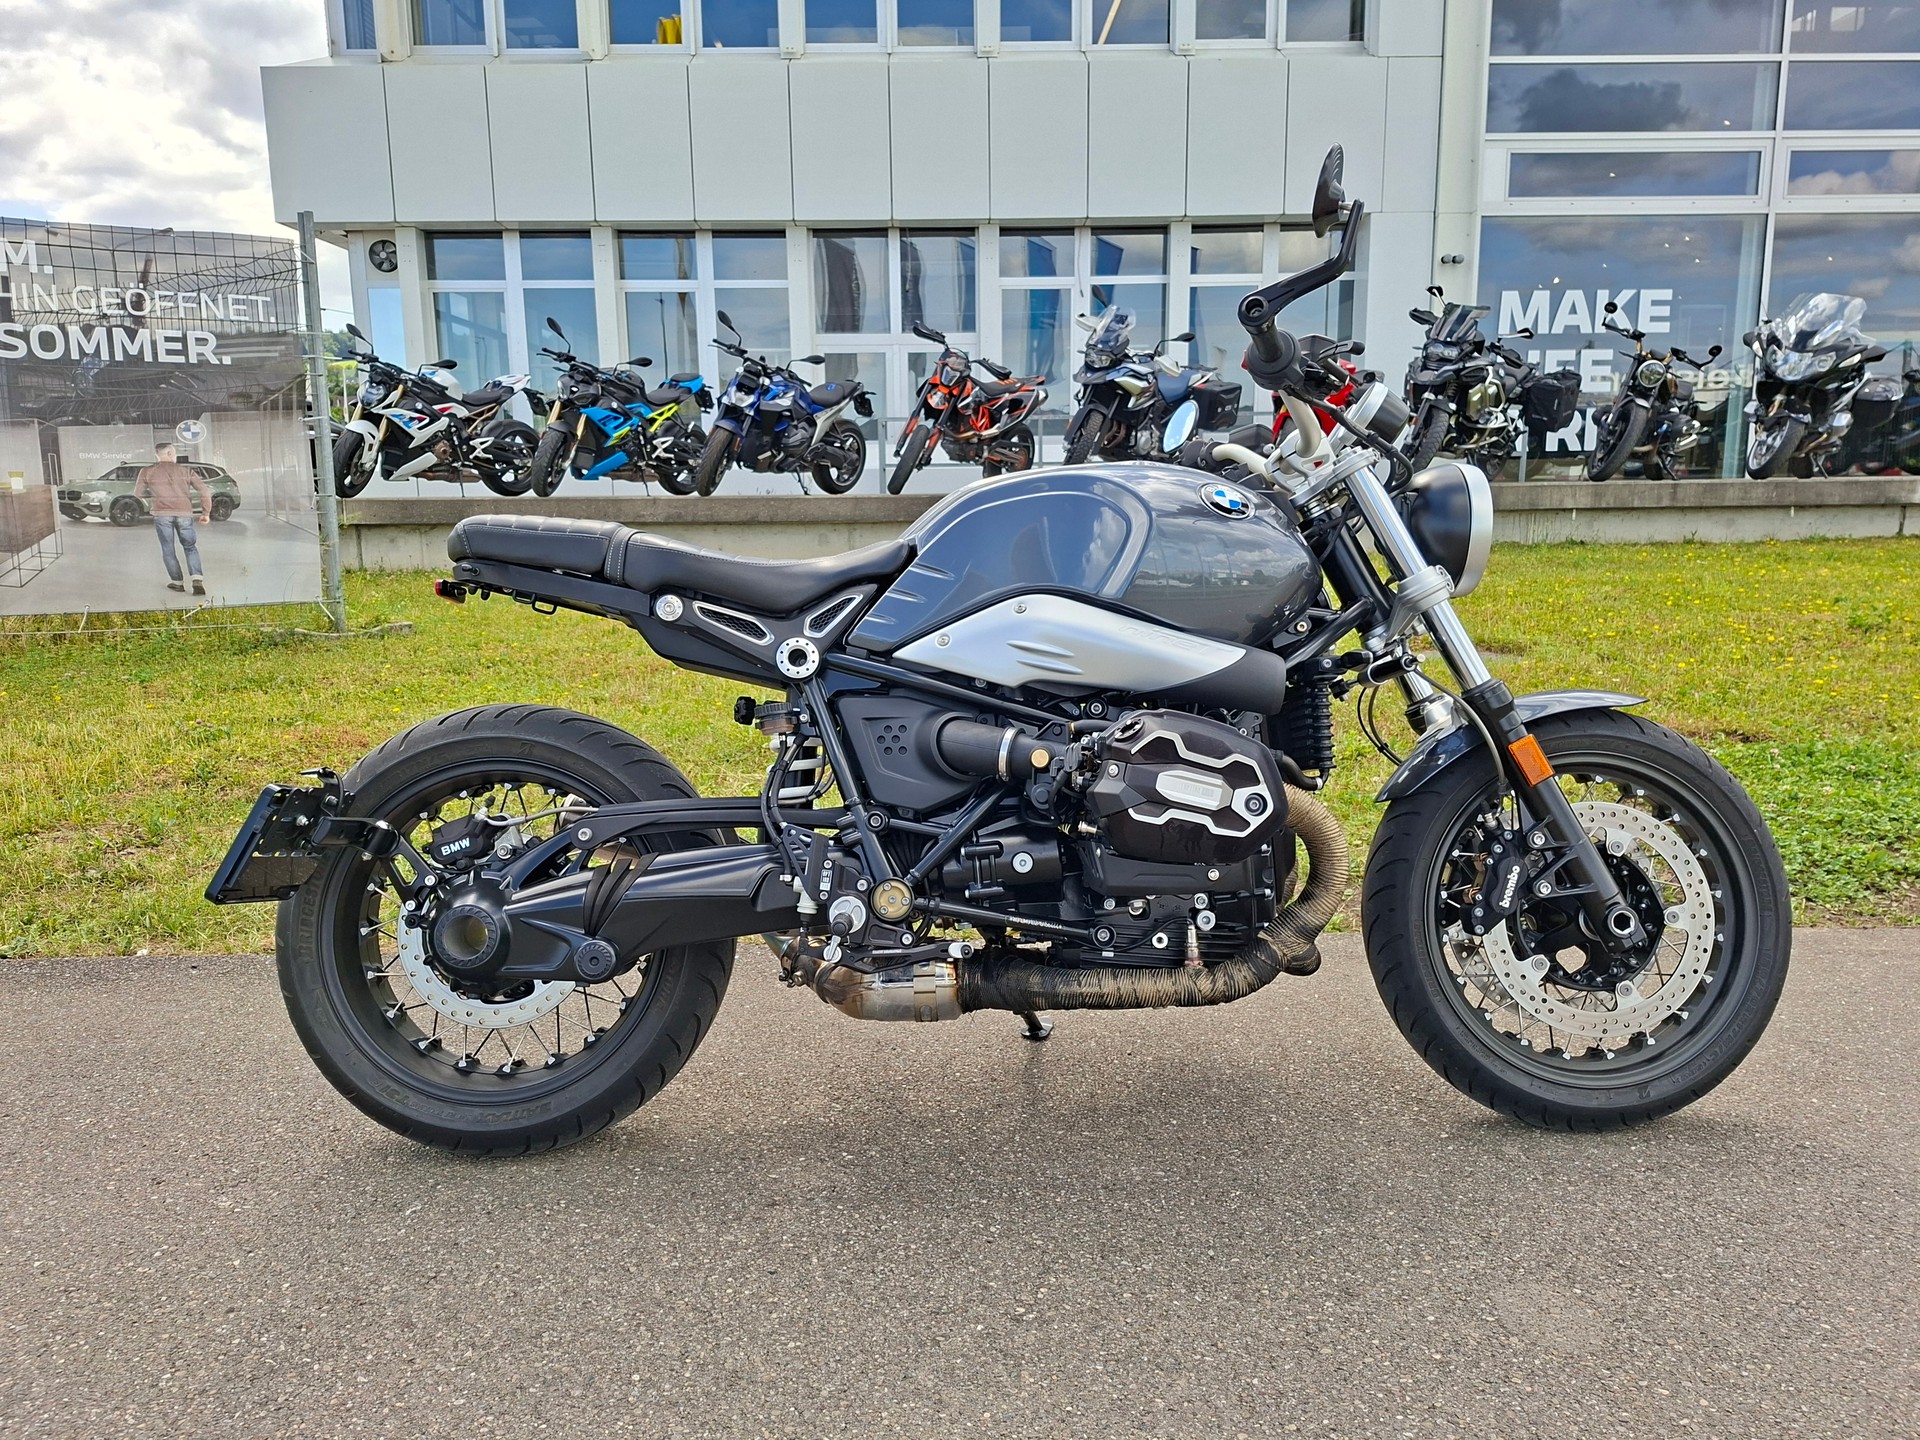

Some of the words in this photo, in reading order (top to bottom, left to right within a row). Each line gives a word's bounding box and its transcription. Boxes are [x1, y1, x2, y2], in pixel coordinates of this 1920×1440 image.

[72, 280, 276, 323] GEÖFFNET.
[1498, 288, 1673, 335] MAKE
[0, 322, 232, 365] SOMMER.
[79, 452, 100, 460] BMW
[102, 452, 132, 460] Service
[441, 837, 470, 856] BMW
[1499, 865, 1520, 908] brembo
